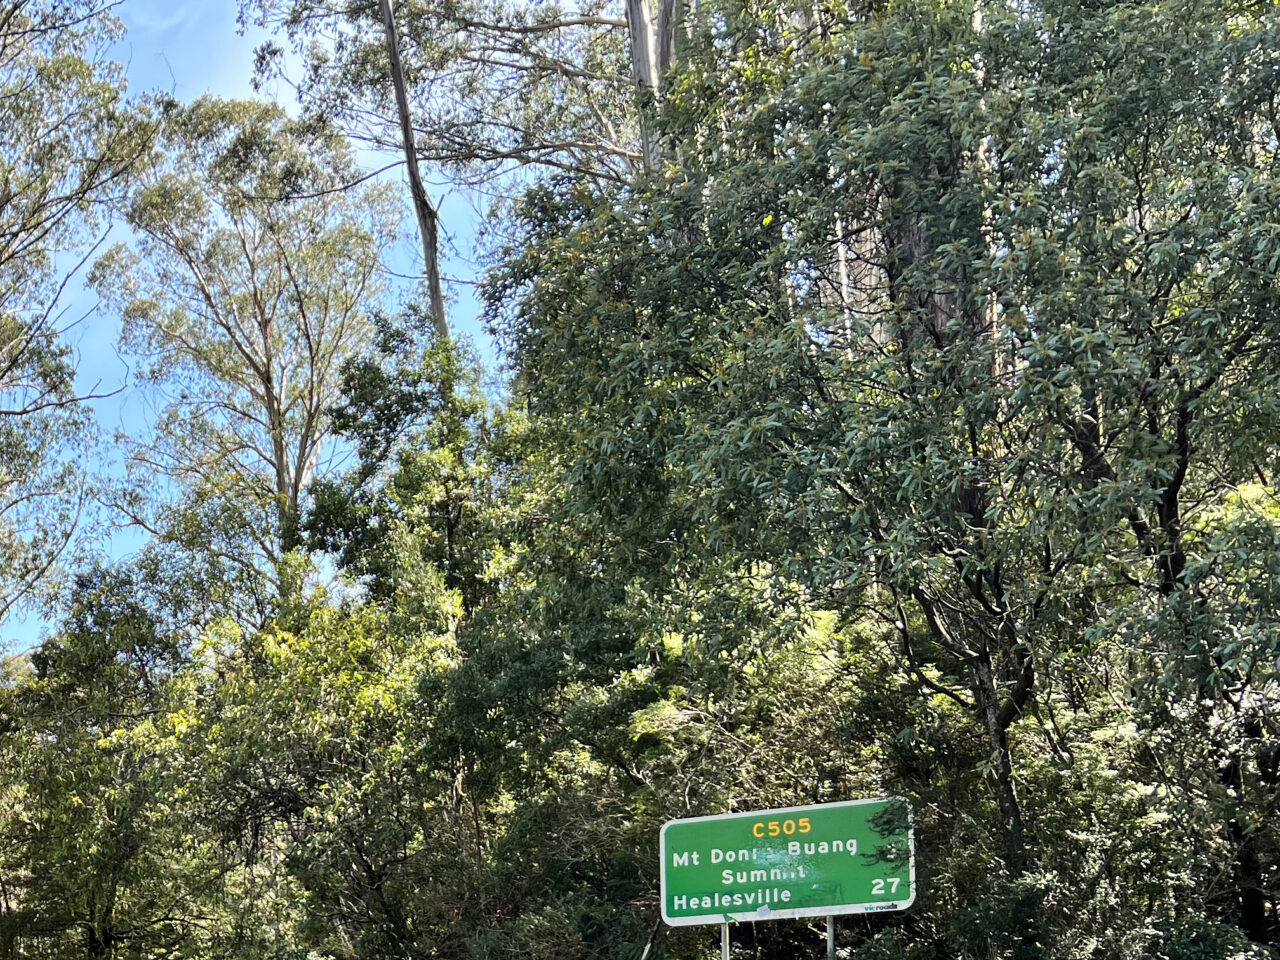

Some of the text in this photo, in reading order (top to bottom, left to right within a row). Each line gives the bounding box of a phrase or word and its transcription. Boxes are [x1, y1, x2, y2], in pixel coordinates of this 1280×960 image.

[752, 817, 811, 838] C505
[673, 851, 699, 867] Mt
[788, 839, 858, 856] Buang
[673, 877, 900, 910] Healesville 27
